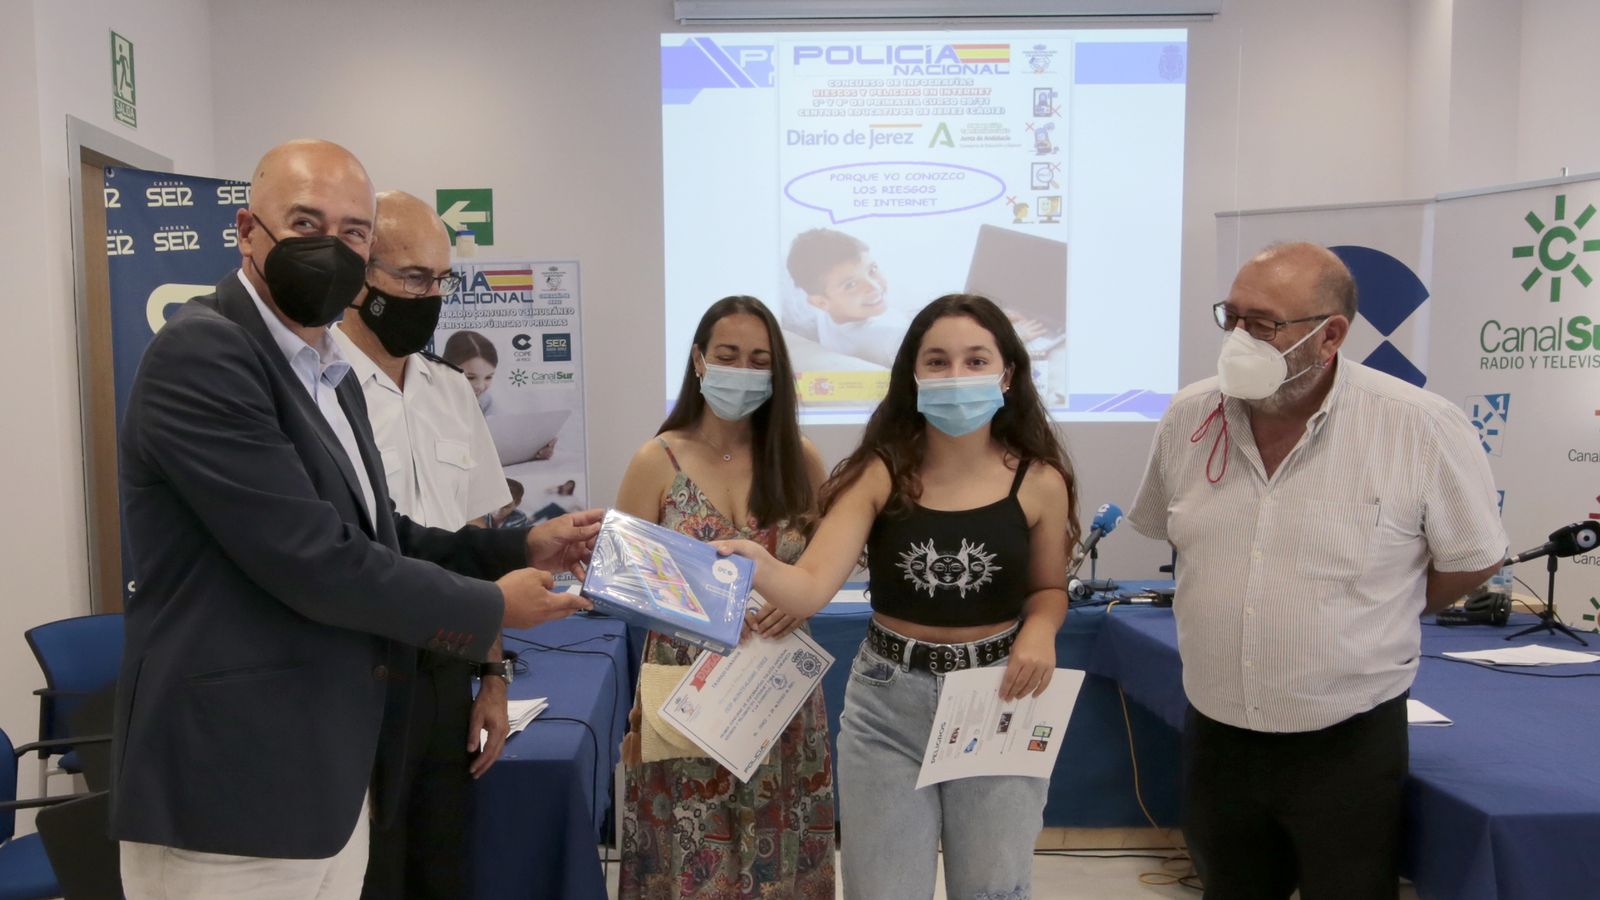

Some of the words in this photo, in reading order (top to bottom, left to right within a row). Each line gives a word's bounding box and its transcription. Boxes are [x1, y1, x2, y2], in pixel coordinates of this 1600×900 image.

[893, 64, 1010, 76] NACIONAL
[827, 78, 884, 88] CONCURSO
[886, 78, 901, 87] DE
[812, 88, 858, 97] RIESGOS
[859, 88, 868, 97] Y
[868, 88, 922, 97] PELIGROS
[923, 88, 938, 96] EN
[939, 87, 992, 96] INTERNET
[850, 98, 865, 107] DE
[866, 98, 921, 106] PRIMARIA
[922, 97, 959, 106] CURSO
[798, 108, 846, 117] CENTROS
[848, 107, 914, 116] EDUCATIVOS
[915, 107, 930, 116] DE
[931, 107, 965, 116] JEREZ
[787, 129, 839, 146] Diario
[842, 129, 866, 145] de
[868, 129, 914, 150] Jerez
[830, 172, 880, 182] PORQUE
[883, 172, 900, 181] YO
[904, 171, 966, 181] CONOZCO
[852, 186, 878, 194] LOS
[881, 185, 937, 194] RIESGOS
[146, 187, 194, 207] SER
[853, 199, 870, 207] DE
[873, 198, 939, 207] INTERNET
[153, 230, 201, 252] SER
[449, 310, 472, 319] RADIO
[473, 309, 517, 319] CONJUNTO
[441, 320, 482, 330] EMISORAS
[482, 319, 522, 329] PÚBLICAS
[530, 319, 568, 328] PRIVADAS
[545, 339, 567, 348] SER
[1480, 356, 1525, 370] RADIO
[1529, 356, 1539, 369] Y
[930, 721, 946, 765] PELIGROS
